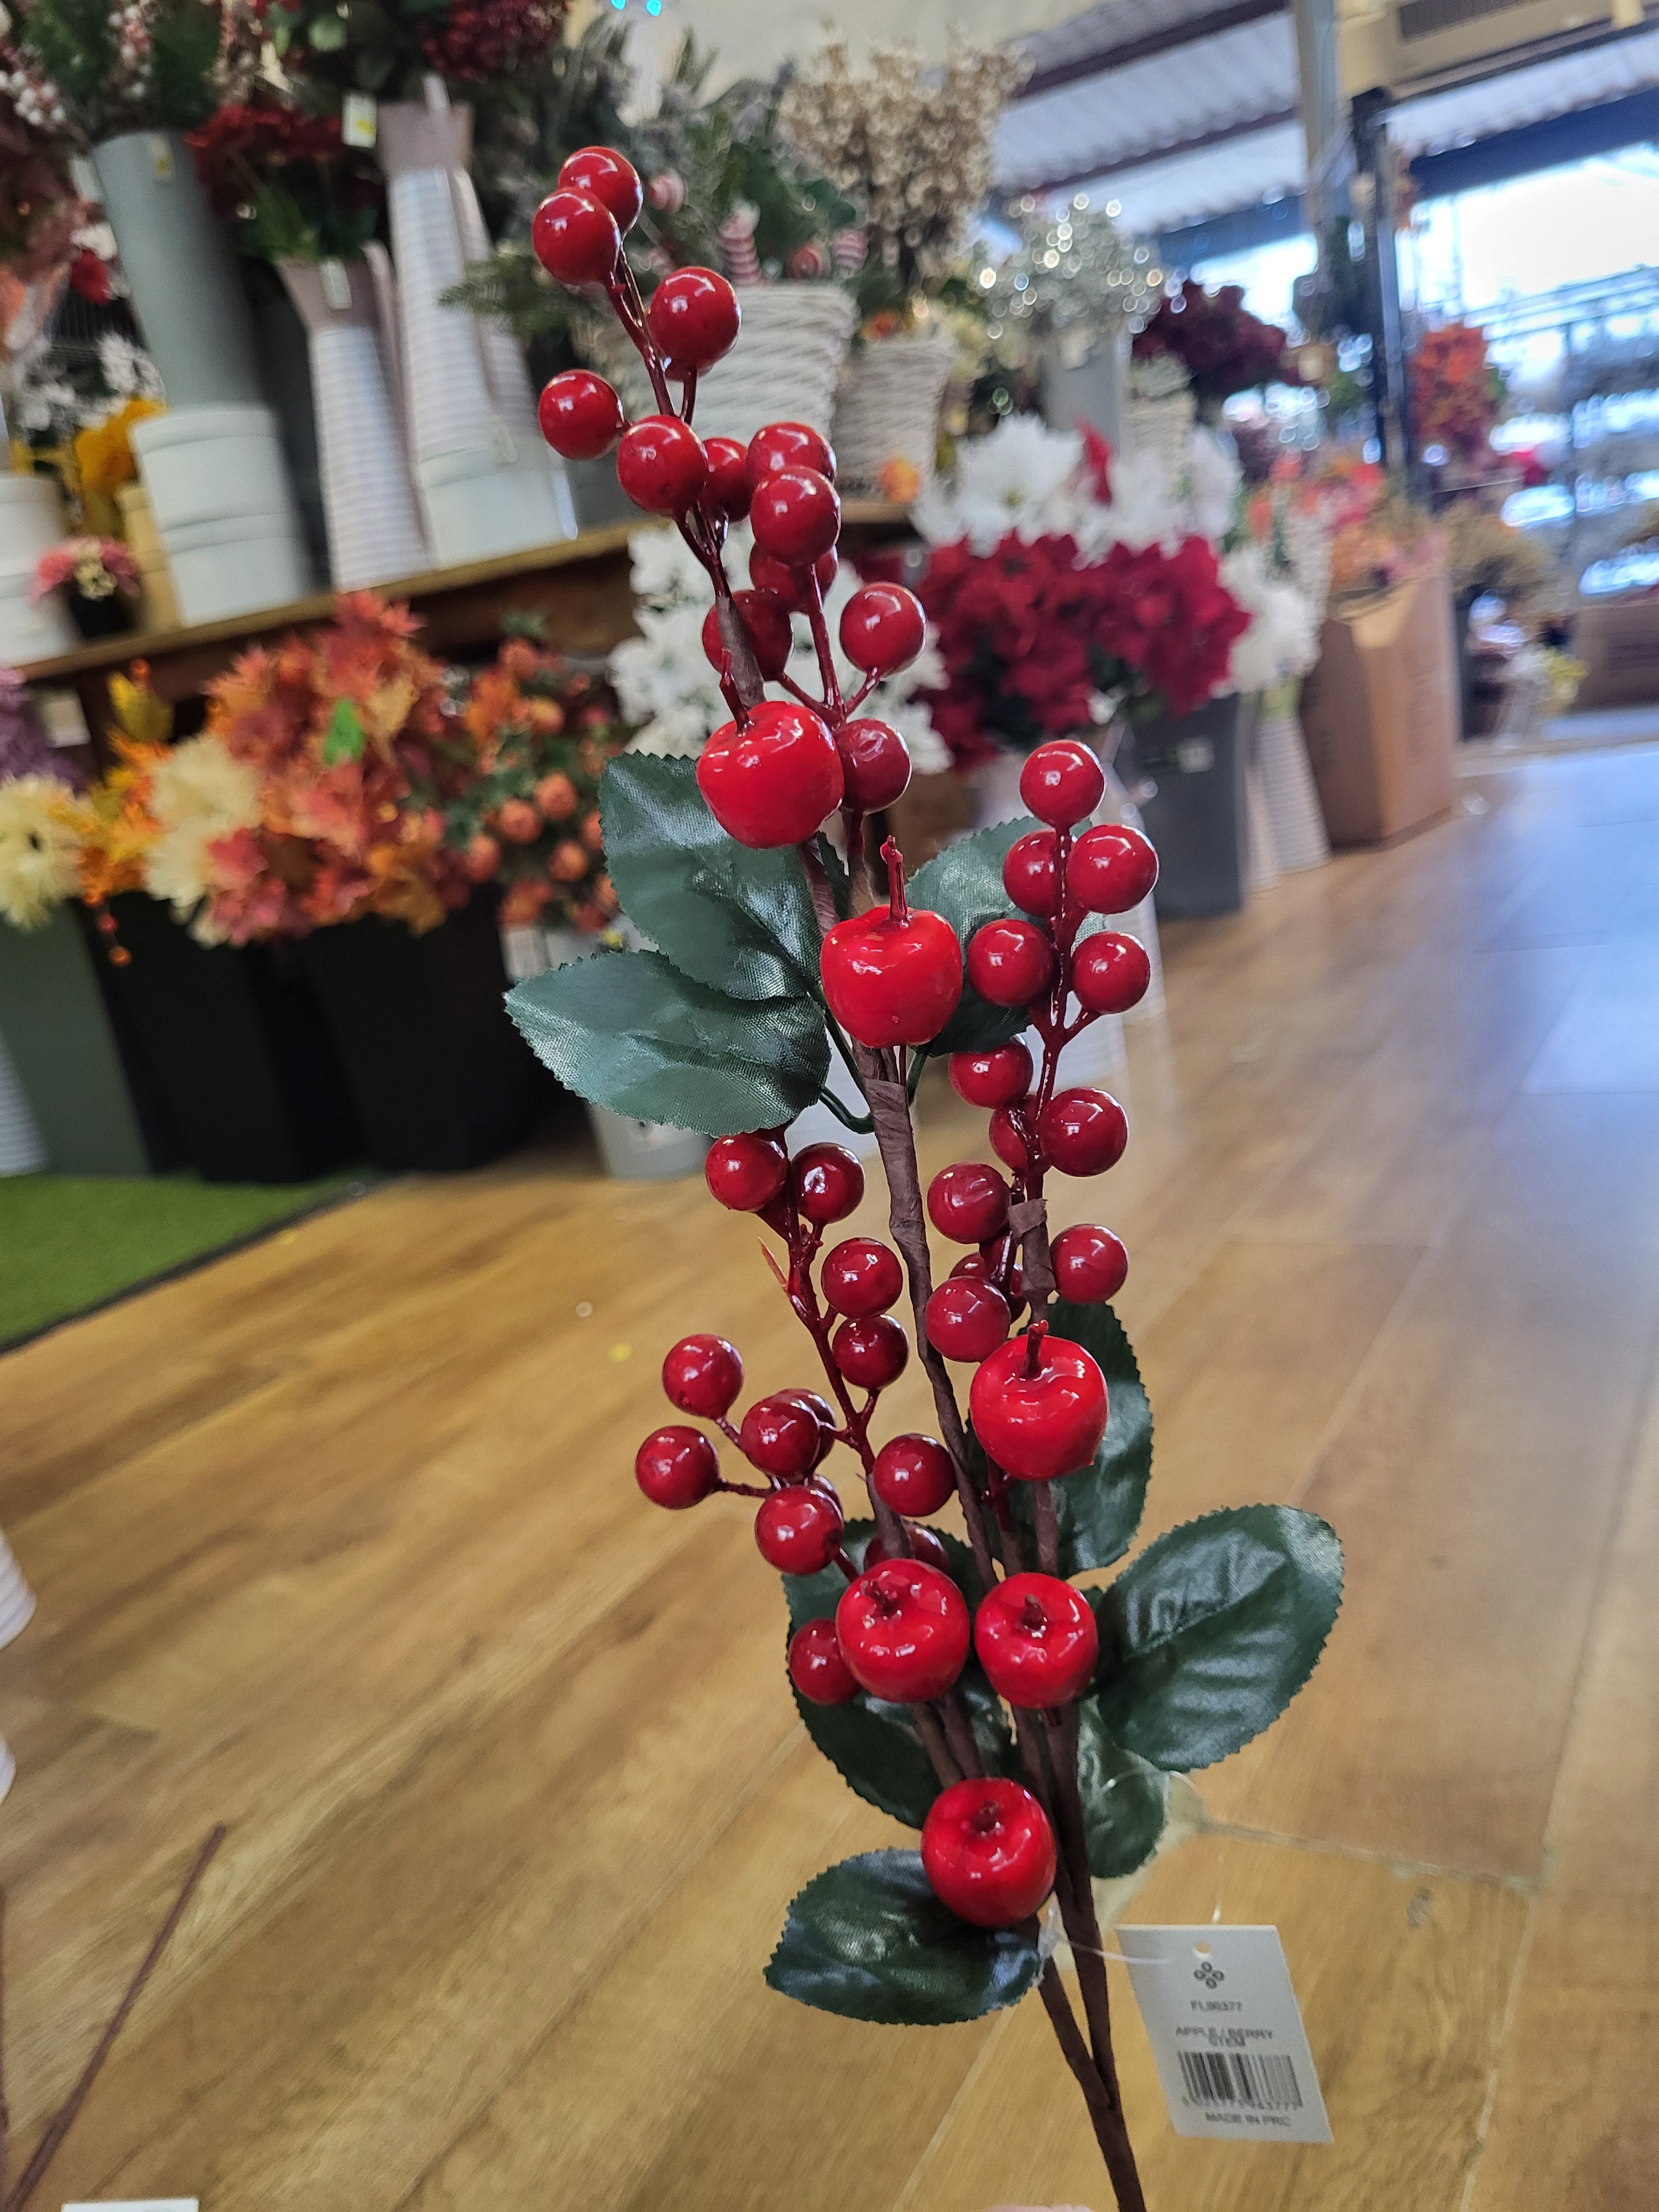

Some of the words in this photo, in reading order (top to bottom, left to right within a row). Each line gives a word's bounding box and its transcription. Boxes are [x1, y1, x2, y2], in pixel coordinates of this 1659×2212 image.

[1176, 2025, 1217, 2038] APPLE
[1228, 2028, 1273, 2039] BERRY
[1205, 2112, 1241, 2124] MADE
[1245, 2114, 1260, 2125] IN
